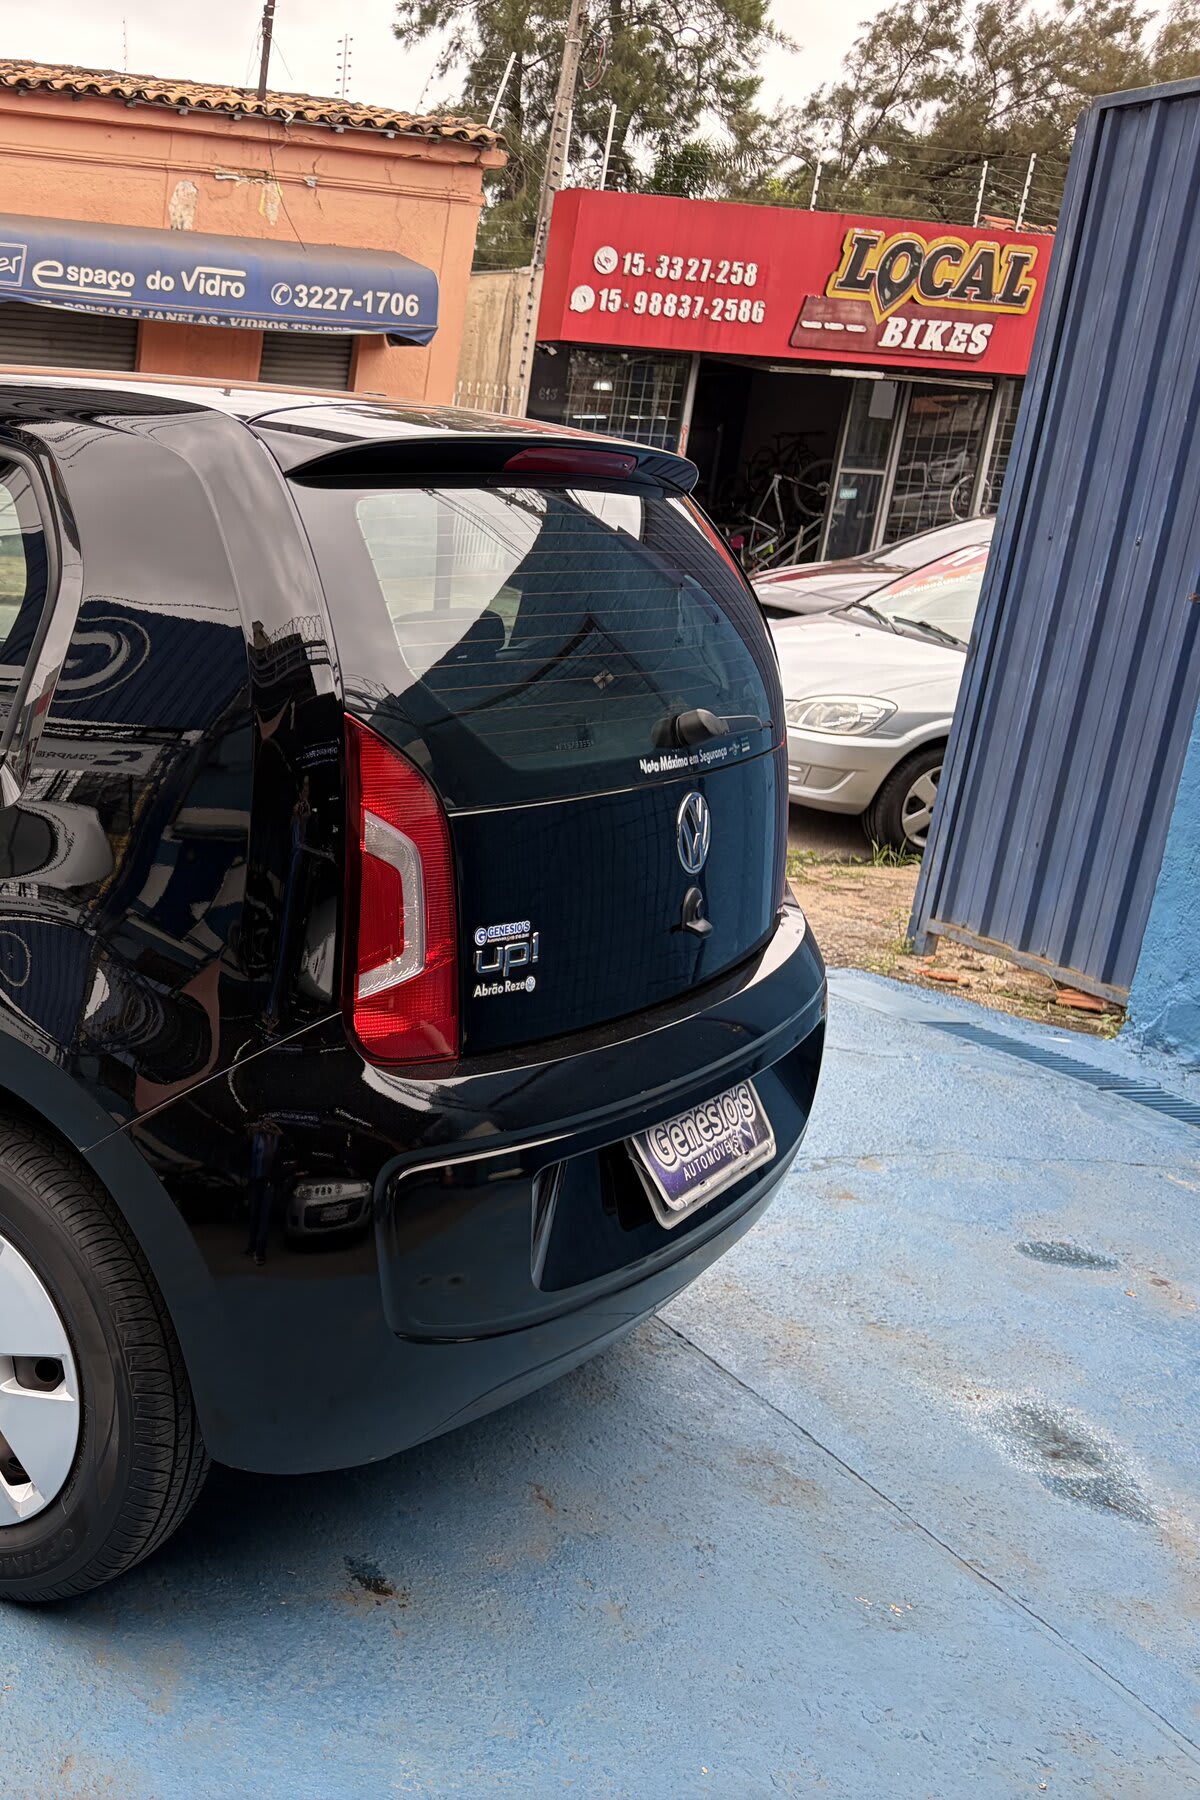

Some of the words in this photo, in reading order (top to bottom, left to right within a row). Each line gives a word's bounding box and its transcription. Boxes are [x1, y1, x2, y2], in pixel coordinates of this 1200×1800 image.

[830, 232, 1035, 313] LOCAL
[32, 260, 135, 297] espaço
[146, 270, 175, 291] do
[181, 266, 247, 298] Vidro
[294, 284, 419, 317] 3227-1706
[877, 316, 993, 355] BIKES
[660, 753, 688, 771] Máxima
[689, 754, 699, 765] em
[699, 747, 728, 764] Segurança
[487, 920, 530, 938] GENESIO'S
[473, 983, 504, 998] Abrão
[504, 980, 526, 993] Reze
